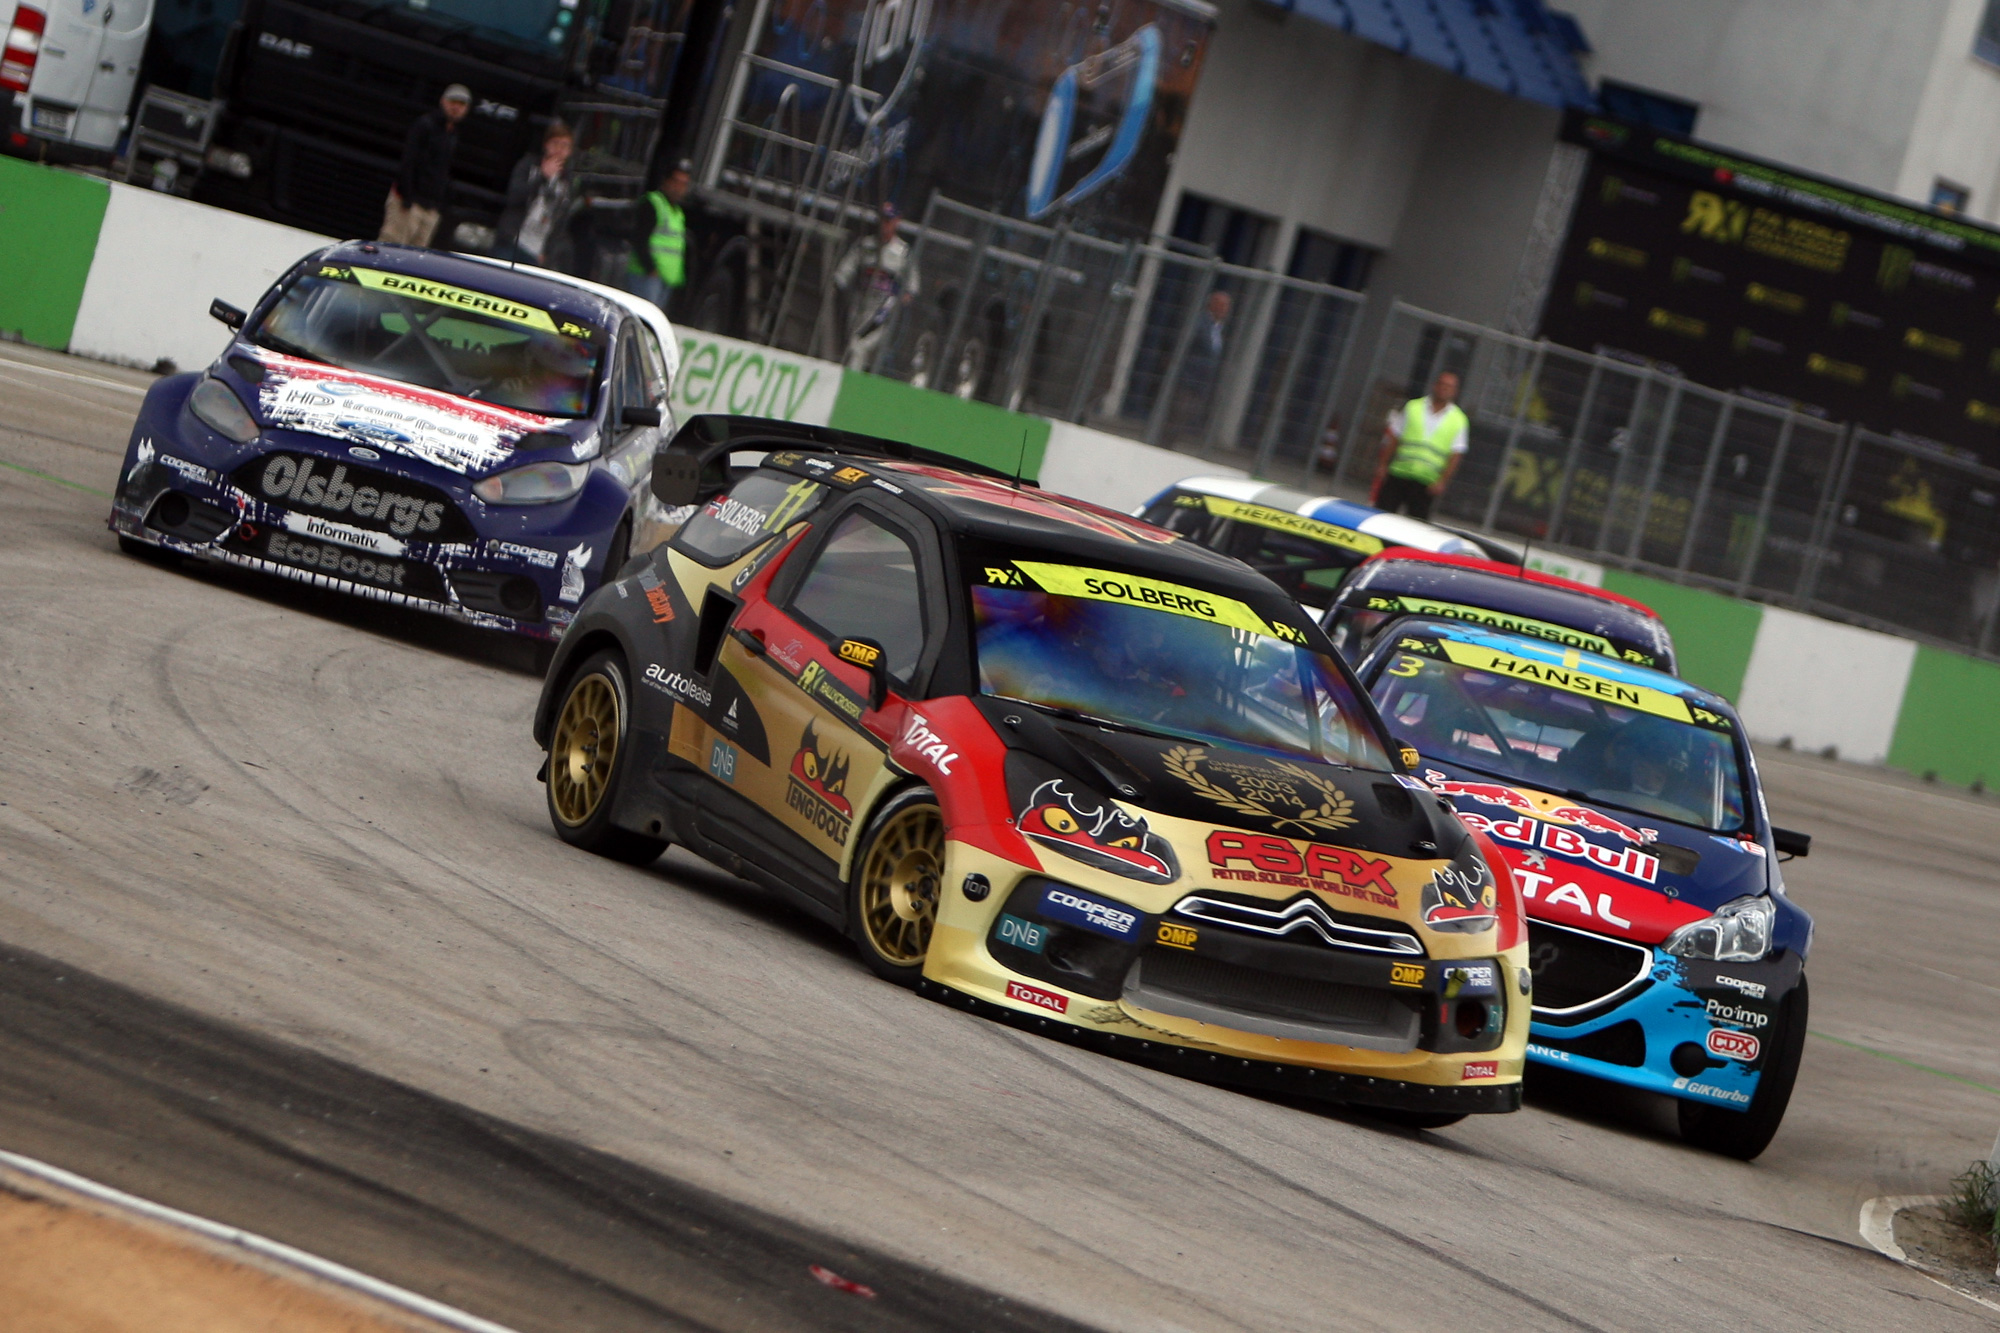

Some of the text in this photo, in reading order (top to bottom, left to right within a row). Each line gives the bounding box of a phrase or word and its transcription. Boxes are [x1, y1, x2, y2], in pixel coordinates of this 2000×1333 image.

[258, 31, 313, 58] DAF
[382, 276, 529, 320] BAKKERUD
[343, 399, 479, 446] transport
[159, 453, 208, 477] COOPER
[262, 455, 445, 535] Olsbergs
[762, 478, 821, 534] 11
[715, 498, 767, 537] SOLBERG
[1233, 504, 1356, 544] HEIKKINEN
[267, 531, 407, 586] EcoBoost
[500, 540, 559, 561] COOPER
[527, 555, 557, 569] TIRES
[1084, 577, 1217, 618] SOLBERG
[838, 642, 879, 664] OMP
[1387, 655, 1426, 679] 3
[645, 662, 713, 708] autolease
[1489, 656, 1641, 705] HANSEN
[903, 713, 960, 776] TOTAL
[711, 744, 735, 779] DNB
[1230, 774, 1297, 795] 2003
[1240, 786, 1307, 809] 2014
[1452, 808, 1661, 885] ed Bull
[1211, 867, 1257, 882] PETTER
[1257, 871, 1309, 889] SOLBERG
[1309, 877, 1351, 897] WORLD
[1369, 890, 1400, 910] TEAM
[1046, 889, 1136, 927] COOPER
[1001, 918, 1041, 947] DNB
[1086, 912, 1131, 935] TIRES
[1157, 924, 1199, 946] OMP
[1390, 965, 1425, 984] OMP
[1444, 966, 1493, 980] CPER
[1715, 974, 1767, 993] COOPER
[1009, 982, 1066, 1012] TOTAL
[1740, 988, 1765, 999] TIRES
[1463, 1064, 1497, 1078] TOTAL
